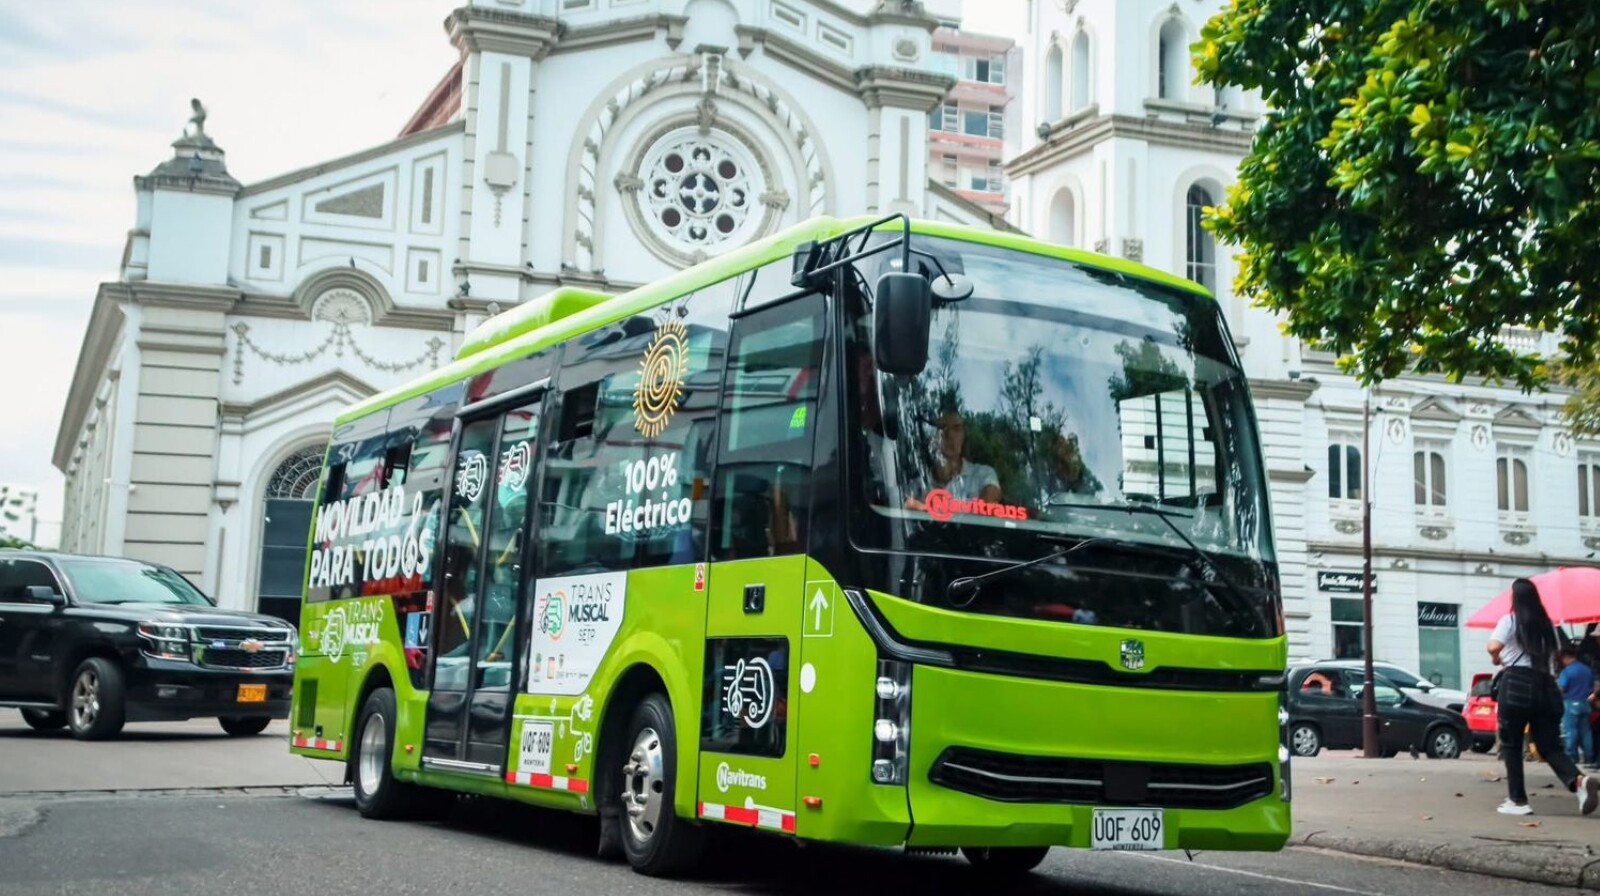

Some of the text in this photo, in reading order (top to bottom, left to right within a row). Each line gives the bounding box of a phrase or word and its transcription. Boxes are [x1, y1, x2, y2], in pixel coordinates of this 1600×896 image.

[624, 452, 677, 495] 100%
[605, 491, 692, 534] Eléctrico
[925, 488, 1028, 522] Navitrans
[309, 545, 354, 588] PARA
[571, 583, 612, 603] TRANS
[349, 599, 385, 622] TRANS
[568, 603, 609, 622] MUSICAL
[345, 622, 381, 645] MUSICAL
[523, 731, 550, 754] UQF 609
[716, 761, 767, 793] Navitrans
[1094, 816, 1161, 842] UQF 609
